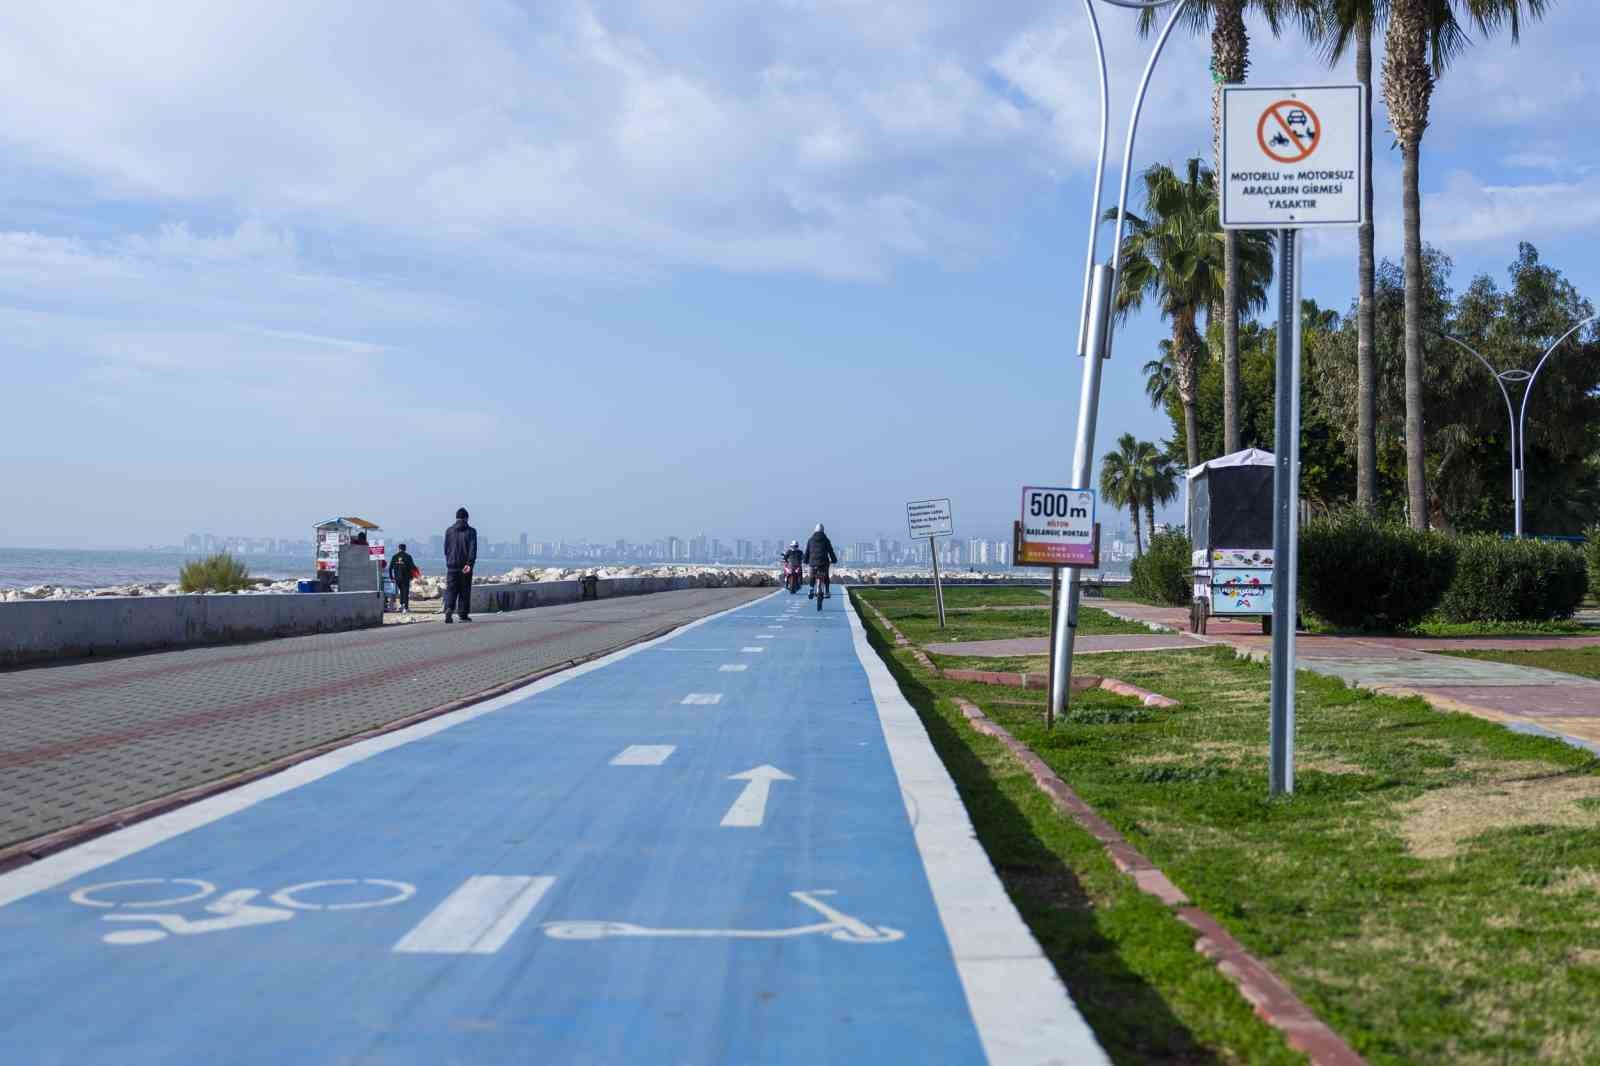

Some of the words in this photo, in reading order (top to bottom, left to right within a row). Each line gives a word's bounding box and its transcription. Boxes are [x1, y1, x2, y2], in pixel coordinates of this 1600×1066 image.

[1231, 172, 1280, 181] MOTORLU
[1297, 170, 1355, 180] MOTORSUZ
[1242, 186, 1299, 196] ARAÇLARIN
[1302, 183, 1343, 195] GİRMESİ
[1268, 200, 1317, 209] YASAKTIR
